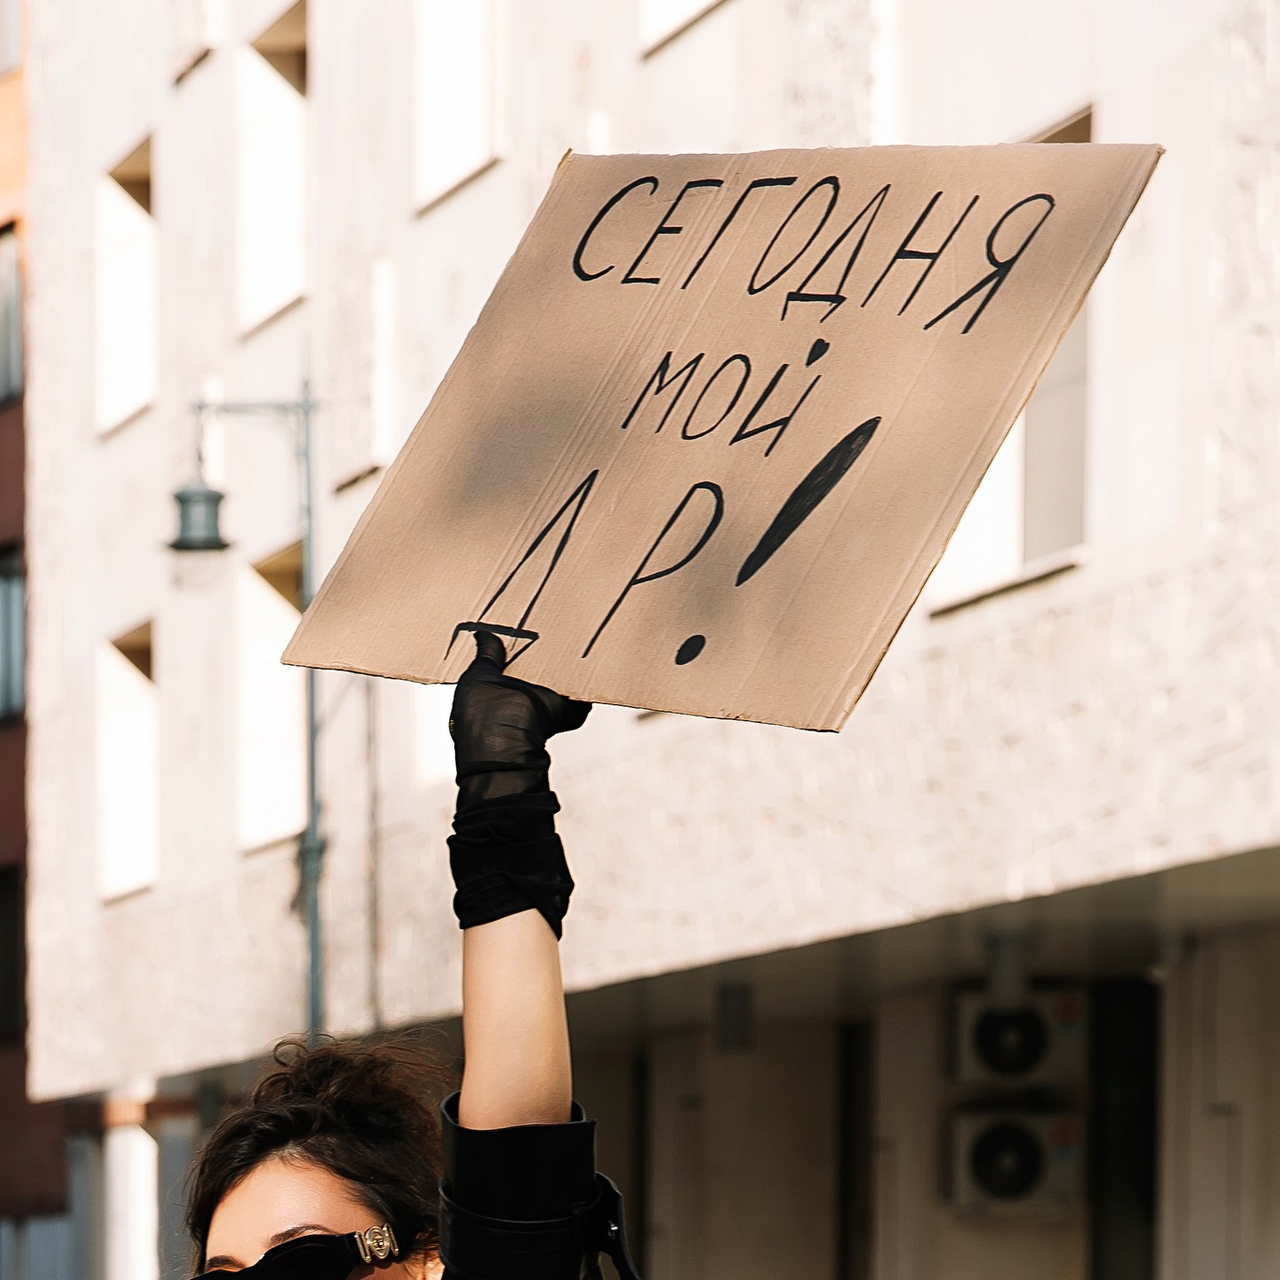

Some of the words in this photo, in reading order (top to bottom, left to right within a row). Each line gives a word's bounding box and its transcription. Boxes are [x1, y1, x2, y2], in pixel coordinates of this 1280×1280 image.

[572, 175, 1056, 335] СЕГОДНЯ
[620, 338, 830, 458] МОЙ
[443, 416, 883, 670] ДР!
